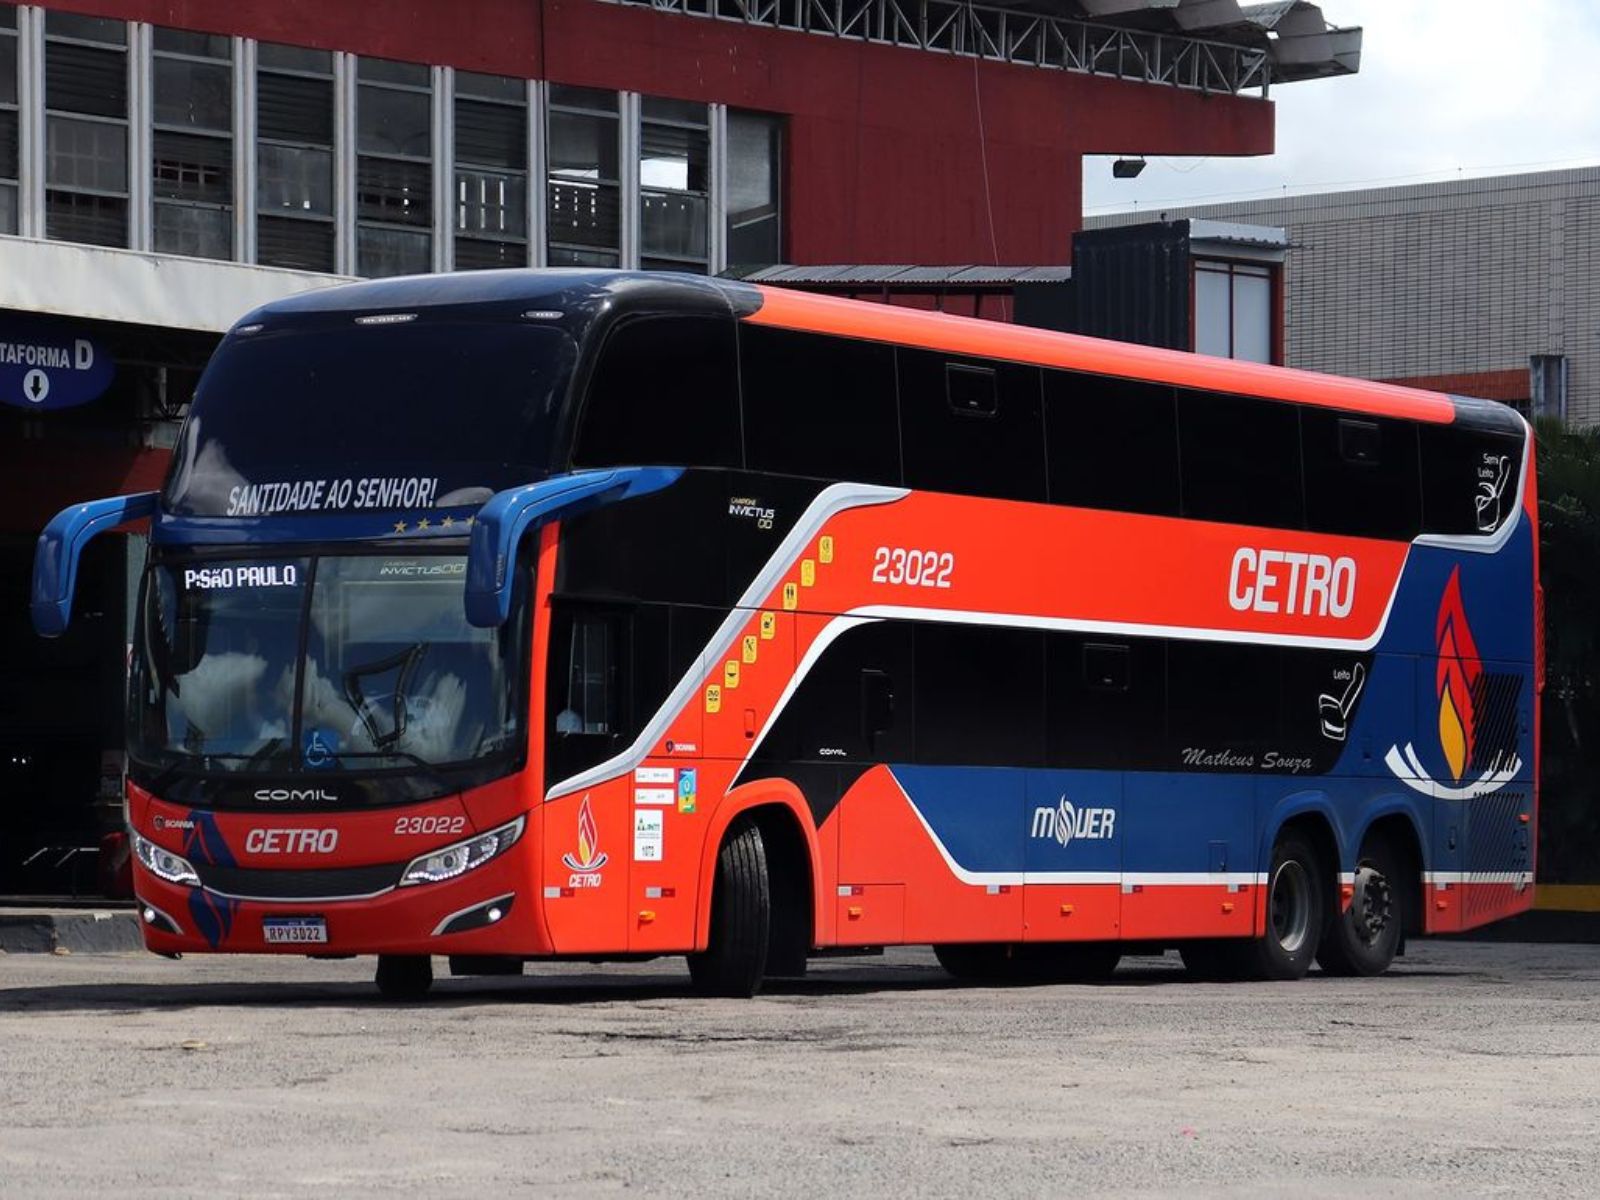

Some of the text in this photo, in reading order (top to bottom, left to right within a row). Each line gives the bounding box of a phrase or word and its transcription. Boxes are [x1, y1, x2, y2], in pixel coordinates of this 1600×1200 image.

[75, 339, 94, 370] D
[1477, 467, 1494, 478] Leito
[227, 478, 438, 516] SANTIDADE AO SENHOR!
[729, 505, 774, 519] INVICTUS
[237, 565, 297, 587] PAULO
[872, 546, 954, 588] 23022
[1228, 547, 1357, 619] CETRO
[1333, 669, 1351, 680] Leito
[254, 789, 338, 801] COMIL
[164, 819, 195, 829] SCANIA
[394, 816, 465, 835] 23022
[246, 828, 338, 854] CETRO
[568, 873, 602, 888] CETRO
